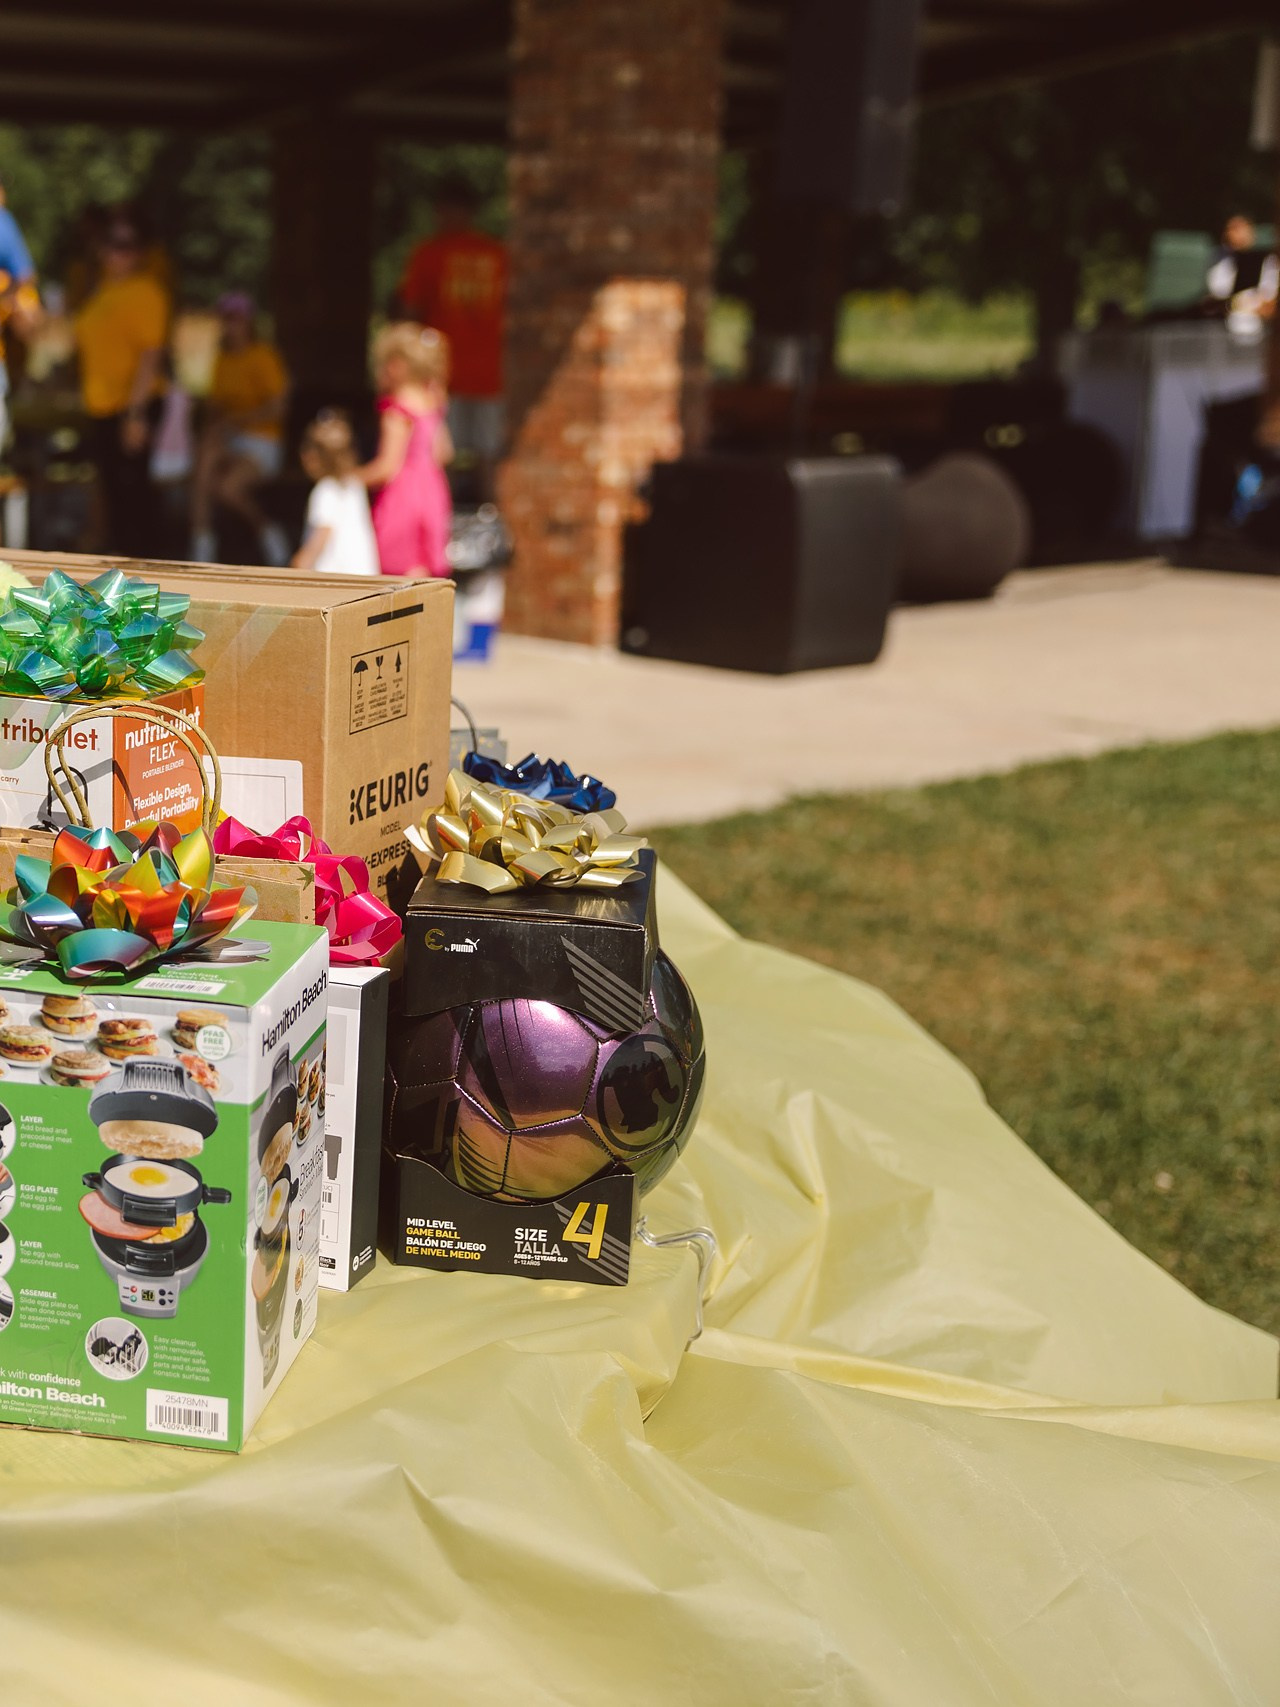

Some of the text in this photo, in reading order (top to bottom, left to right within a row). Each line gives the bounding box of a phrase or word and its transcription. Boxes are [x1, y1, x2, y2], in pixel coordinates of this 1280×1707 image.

[142, 758, 184, 779] PORTABLE BLENDER
[0, 776, 19, 784] carry
[133, 782, 192, 812] Flexible Design,
[349, 762, 429, 825] KEURIG
[161, 796, 199, 820] Portability
[380, 820, 401, 837] MODEL
[450, 943, 474, 953] PUMA
[262, 969, 327, 1057] Hamilton Beach
[203, 1037, 224, 1045] FREE
[20, 1115, 43, 1123] LAYER
[35, 1125, 54, 1133] bread
[20, 1133, 55, 1142] precooked
[28, 1141, 52, 1150] cheese
[20, 1184, 59, 1194] EGG PLATE
[20, 1192, 34, 1200] Add
[34, 1195, 47, 1203] egg
[31, 1203, 45, 1211] egg
[45, 1203, 62, 1212] plate
[406, 1217, 457, 1230] MID LEVEL
[561, 1201, 609, 1259] 4
[406, 1227, 461, 1240] GAME BALL
[514, 1227, 548, 1242] SIZE
[19, 1240, 42, 1248] LAYER
[406, 1237, 487, 1252] BALÓN DE JUEGO
[514, 1240, 561, 1256] TALLA
[19, 1248, 32, 1256] Top
[405, 1246, 481, 1260] DE NIVEL MEDIO
[19, 1257, 79, 1270] second bread slice
[20, 1288, 57, 1299] ASSEMBLE
[20, 1296, 36, 1304] Slide
[50, 1300, 67, 1308] plate
[28, 1315, 58, 1324] assemble
[38, 1307, 55, 1315] done
[56, 1310, 81, 1320] cooking
[20, 1322, 50, 1330] sandwich
[153, 1335, 197, 1347] Easy cleanup
[169, 1346, 205, 1357] removable,
[153, 1352, 207, 1365] dishwasher safe
[170, 1363, 184, 1371] and
[8, 1368, 28, 1379] with
[29, 1372, 81, 1387] confidence
[153, 1369, 210, 1382] nonstick surfaces
[46, 1386, 106, 1408] Beach
[165, 1394, 209, 1408] 25478MN
